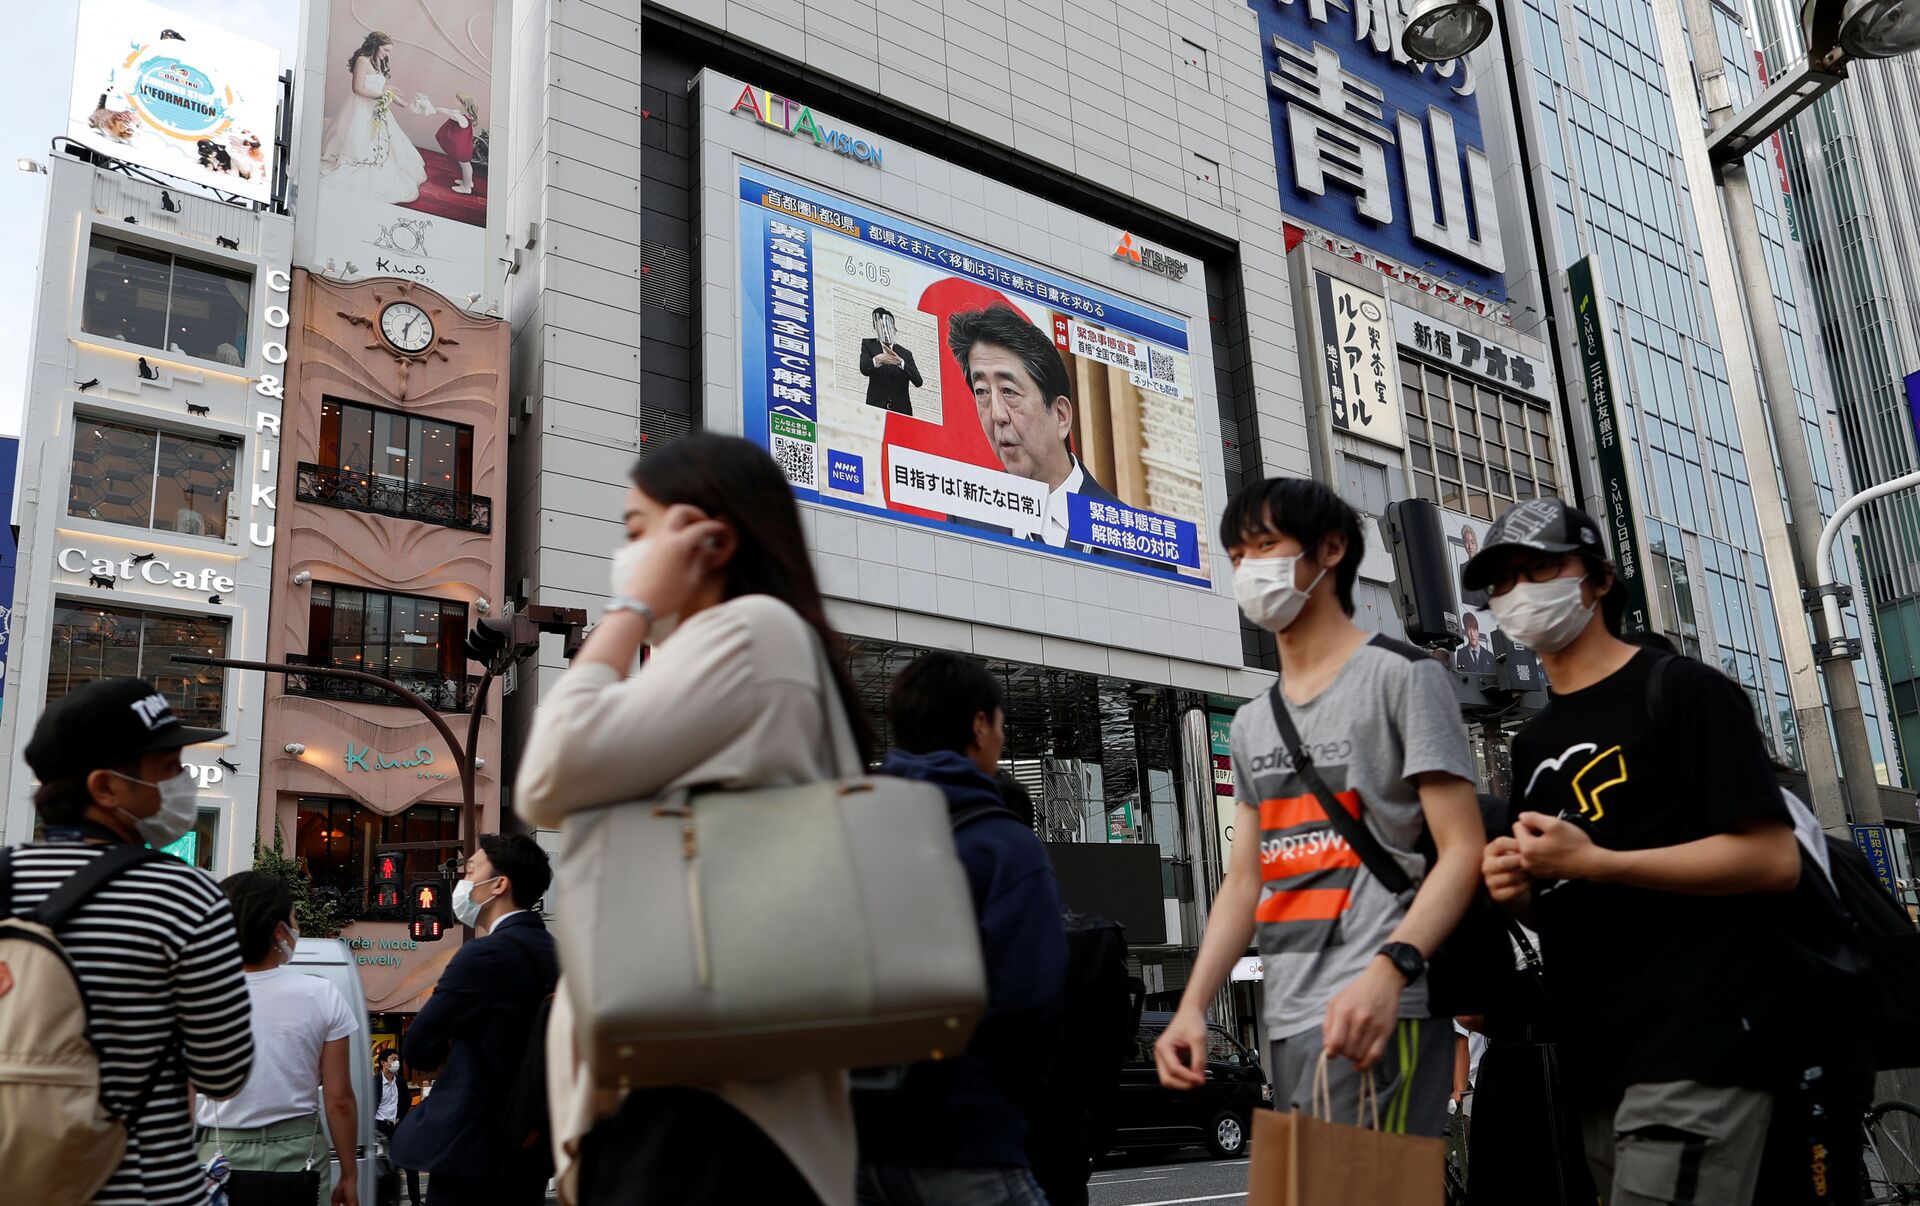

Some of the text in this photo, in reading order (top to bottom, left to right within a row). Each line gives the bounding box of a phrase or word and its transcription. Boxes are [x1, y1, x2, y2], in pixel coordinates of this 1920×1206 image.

[730, 83, 884, 167] ALTA VISION
[1269, 34, 1505, 273] 青山
[767, 190, 857, 233] 首都圏1都3県
[844, 255, 891, 287] 6:05
[1140, 246, 1188, 274] MITSUBISHI
[1141, 256, 1184, 280] ELECTRIC
[1583, 313, 1597, 356] SMBC
[1338, 293, 1373, 427] ルノアール
[1367, 325, 1388, 405] 喫茶室
[832, 470, 860, 484] NEWS
[834, 461, 857, 473] NHK
[895, 464, 1042, 517] 目指すは「新たな日常」
[1089, 500, 1177, 539] 緊急事態宣言
[1091, 523, 1180, 560] 解除後の対応
[57, 548, 234, 594] Cat Cafe
[1312, 740, 1352, 761] neo
[379, 938, 418, 951] Made
